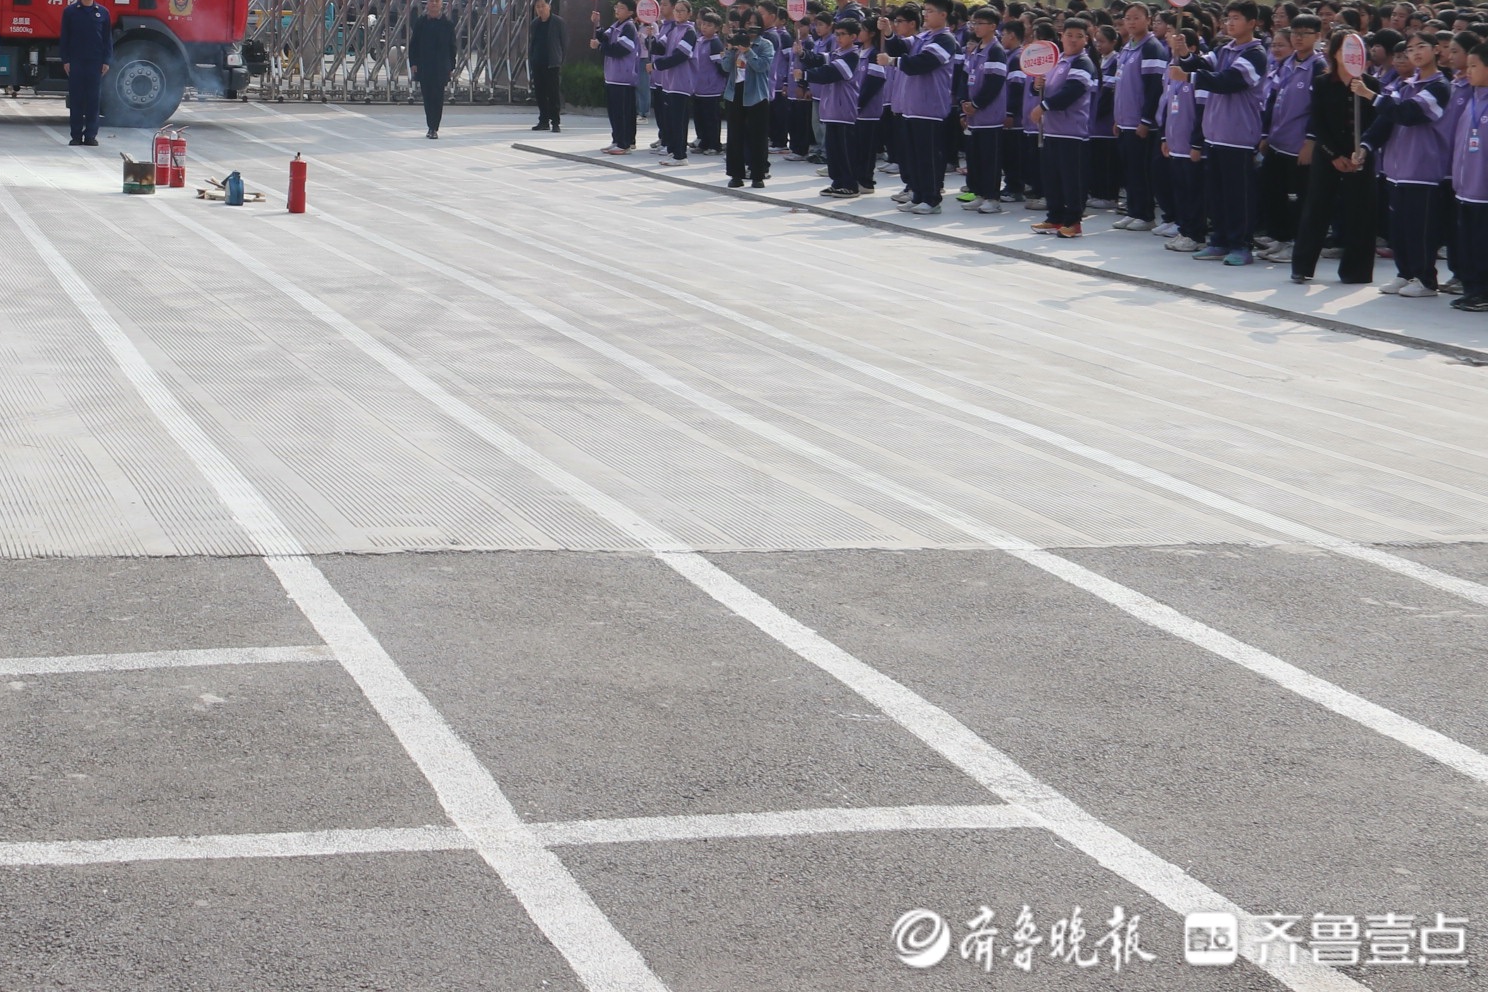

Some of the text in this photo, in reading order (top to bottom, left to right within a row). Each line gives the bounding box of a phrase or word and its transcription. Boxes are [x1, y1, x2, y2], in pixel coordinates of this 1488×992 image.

[12, 17, 31, 25] 总质量
[10, 26, 33, 35] 15800kg
